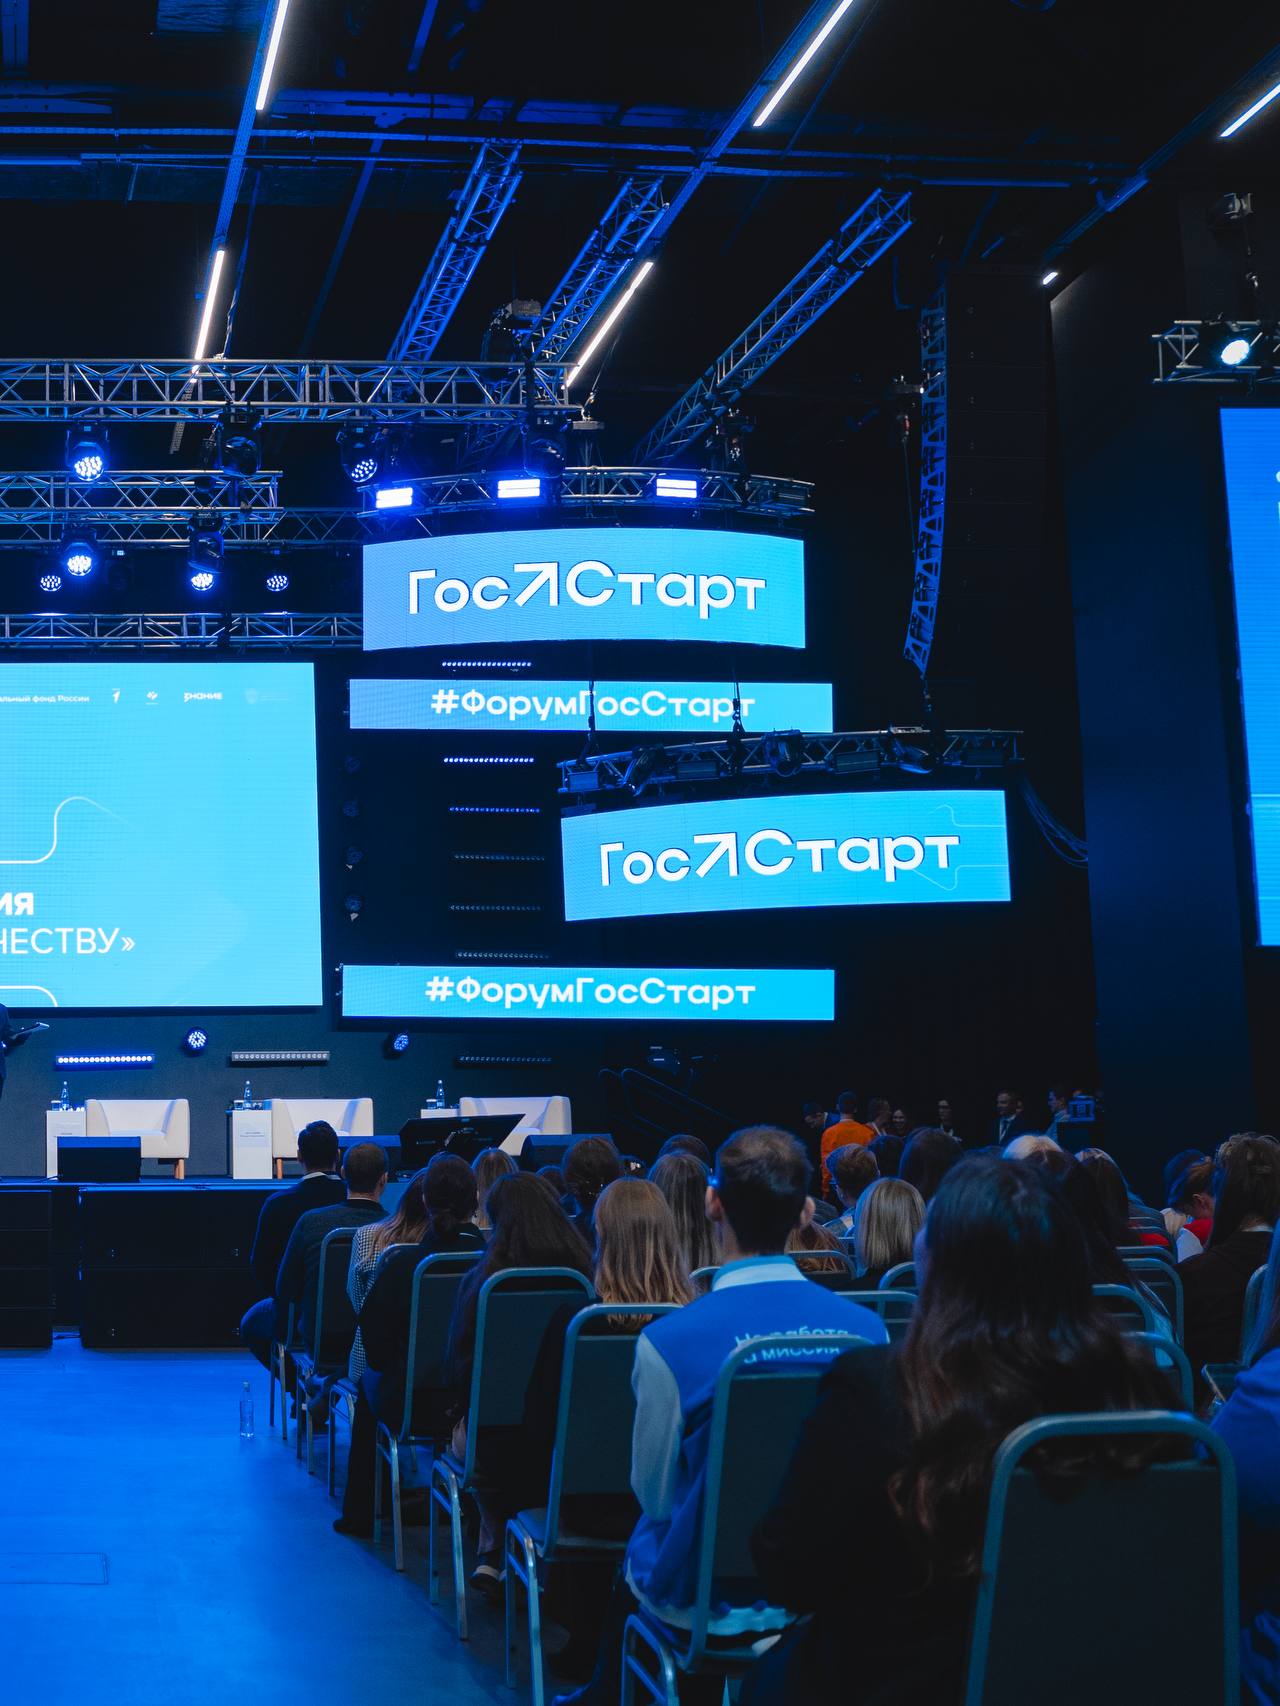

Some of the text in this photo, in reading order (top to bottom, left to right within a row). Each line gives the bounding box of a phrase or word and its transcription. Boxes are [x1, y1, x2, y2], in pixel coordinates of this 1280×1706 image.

[31, 694, 57, 704] фонд
[57, 693, 90, 703] России
[430, 688, 756, 723] #ФорумГосСтарт
[425, 975, 756, 1011] #ФорумГосСтарт
